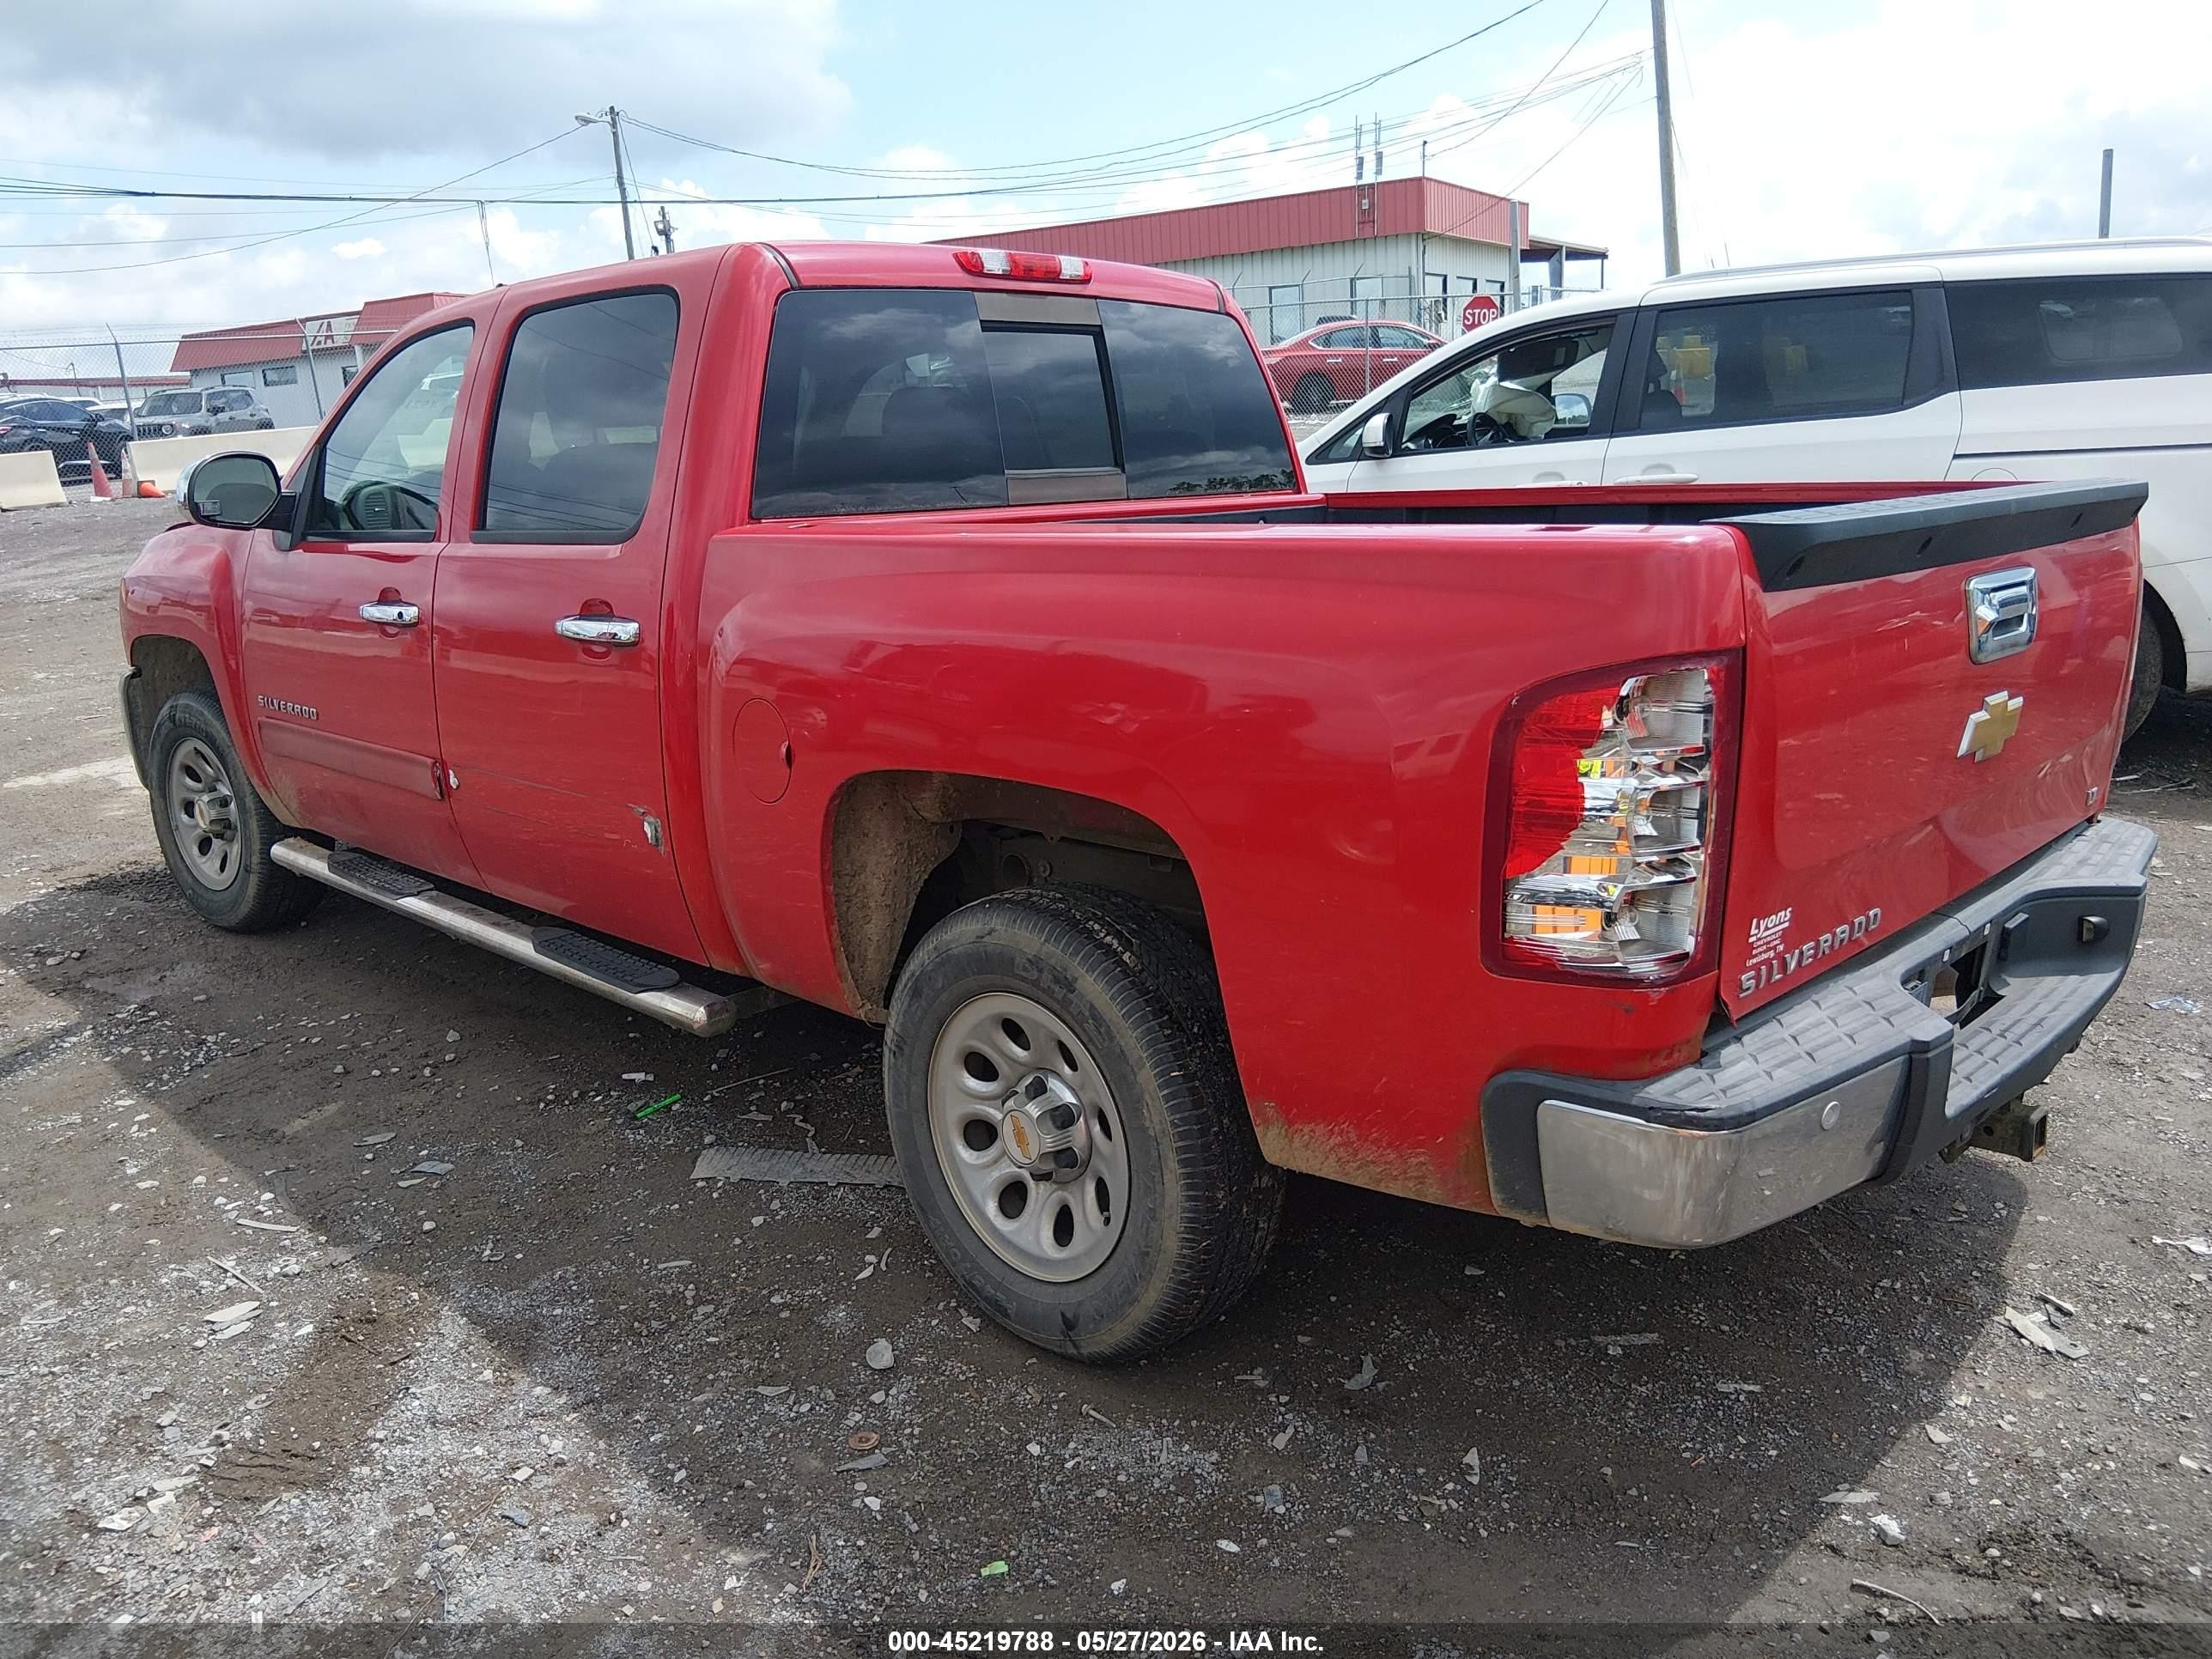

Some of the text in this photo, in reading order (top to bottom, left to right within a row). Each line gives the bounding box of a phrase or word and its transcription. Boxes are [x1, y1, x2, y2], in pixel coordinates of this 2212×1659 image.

[1464, 308, 1498, 325] STOP
[258, 695, 317, 720] SILVERADO
[1749, 907, 1793, 939] Lyons
[1738, 907, 1881, 998] SILVERADO
[1776, 943, 1784, 953] TN
